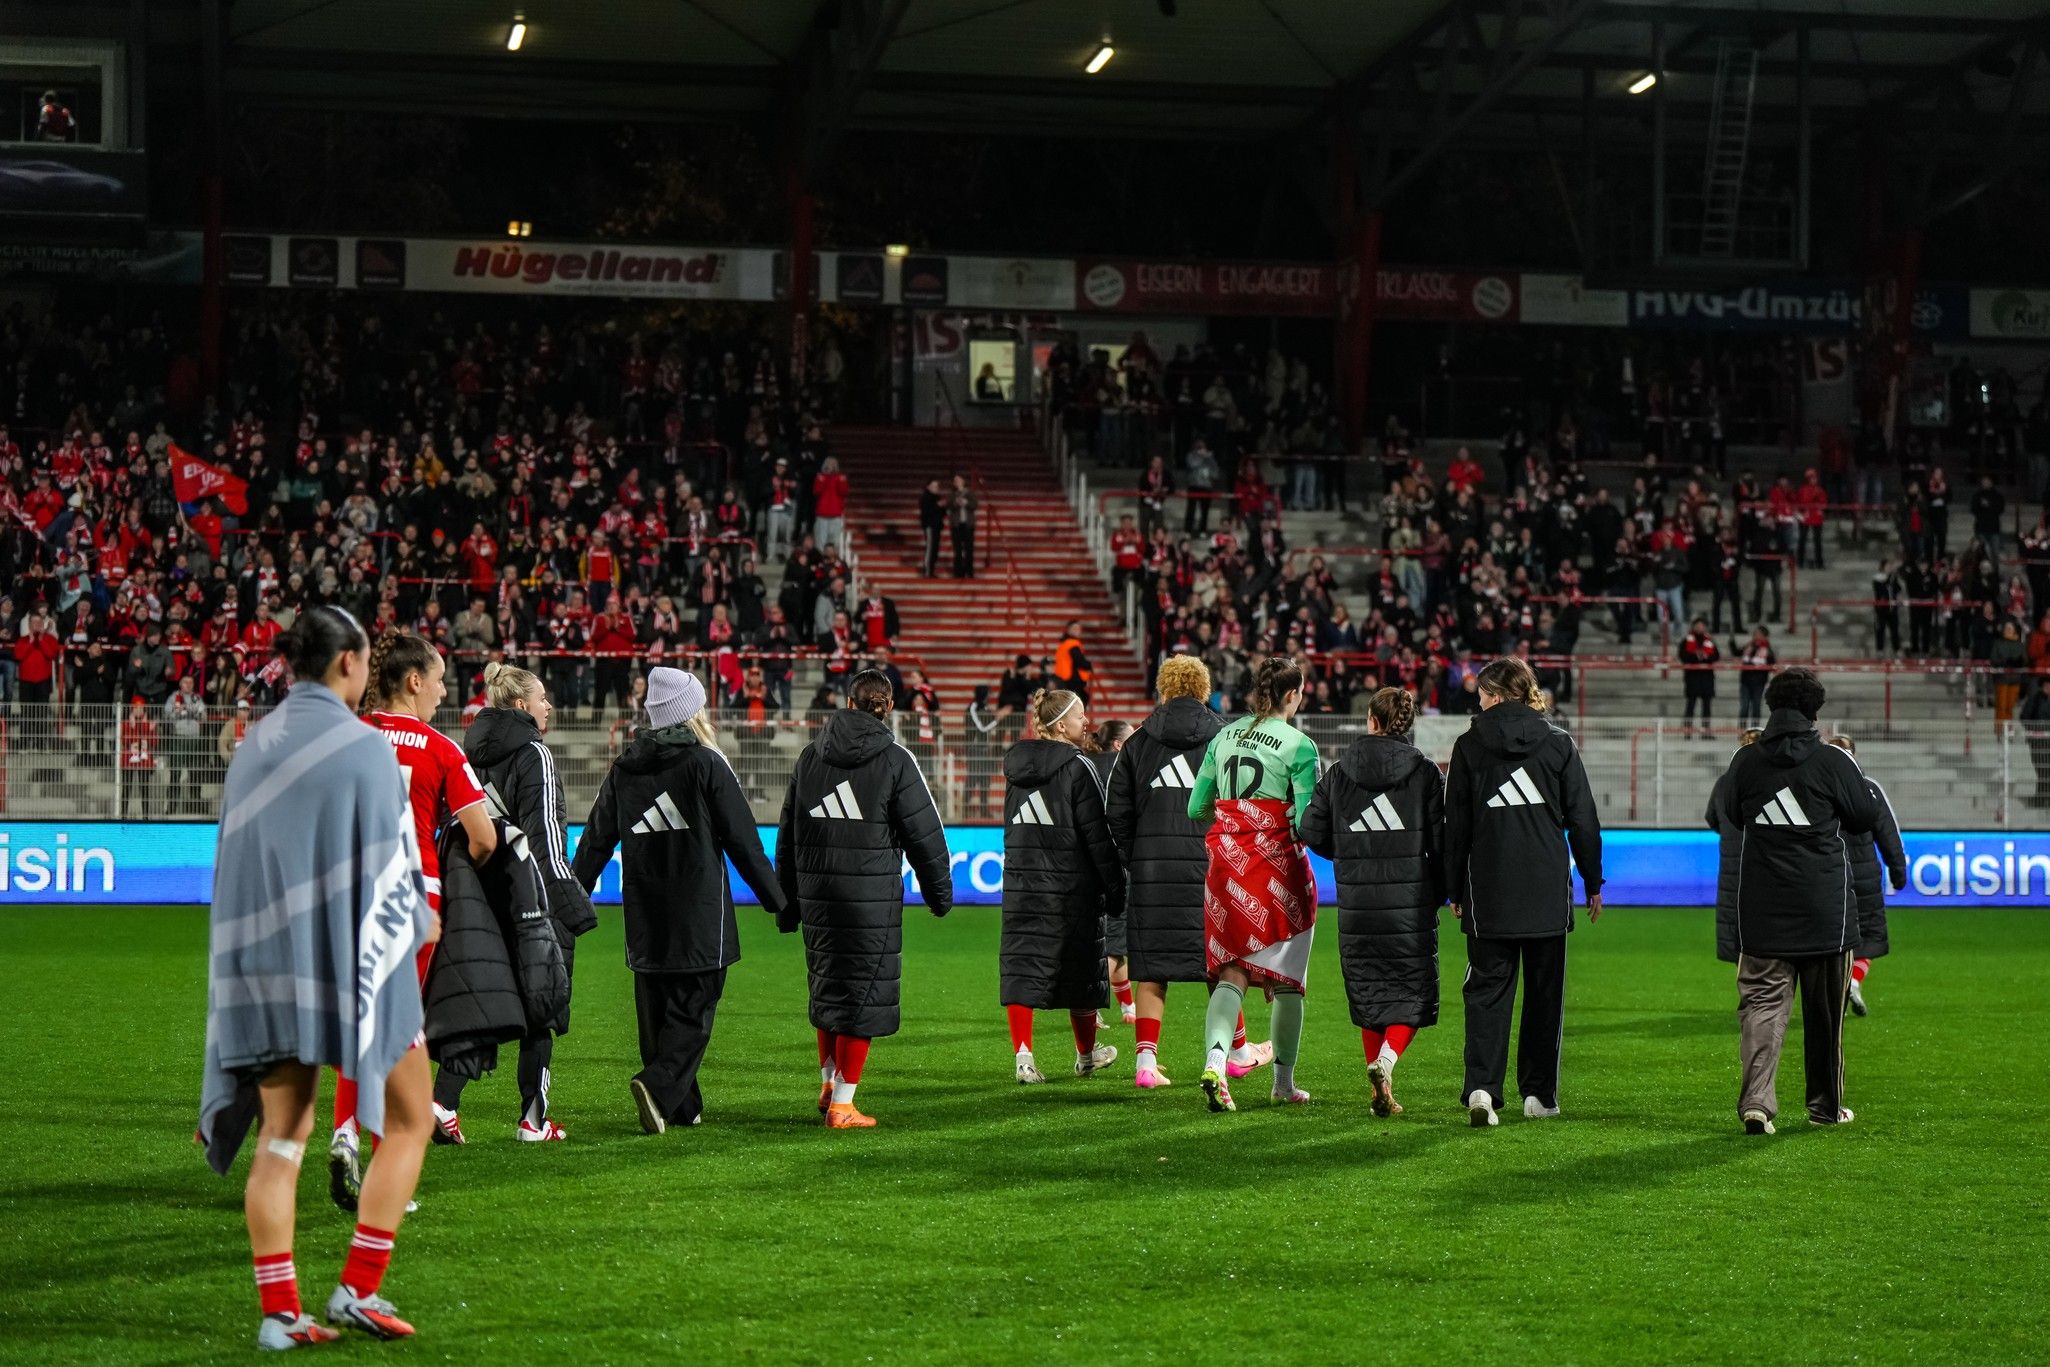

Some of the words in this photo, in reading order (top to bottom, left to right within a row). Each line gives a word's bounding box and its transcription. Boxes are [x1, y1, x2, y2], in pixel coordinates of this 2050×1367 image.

[453, 247, 718, 283] Hügelland
[1236, 740, 1258, 751] BERLIN
[1224, 754, 1264, 799] 12
